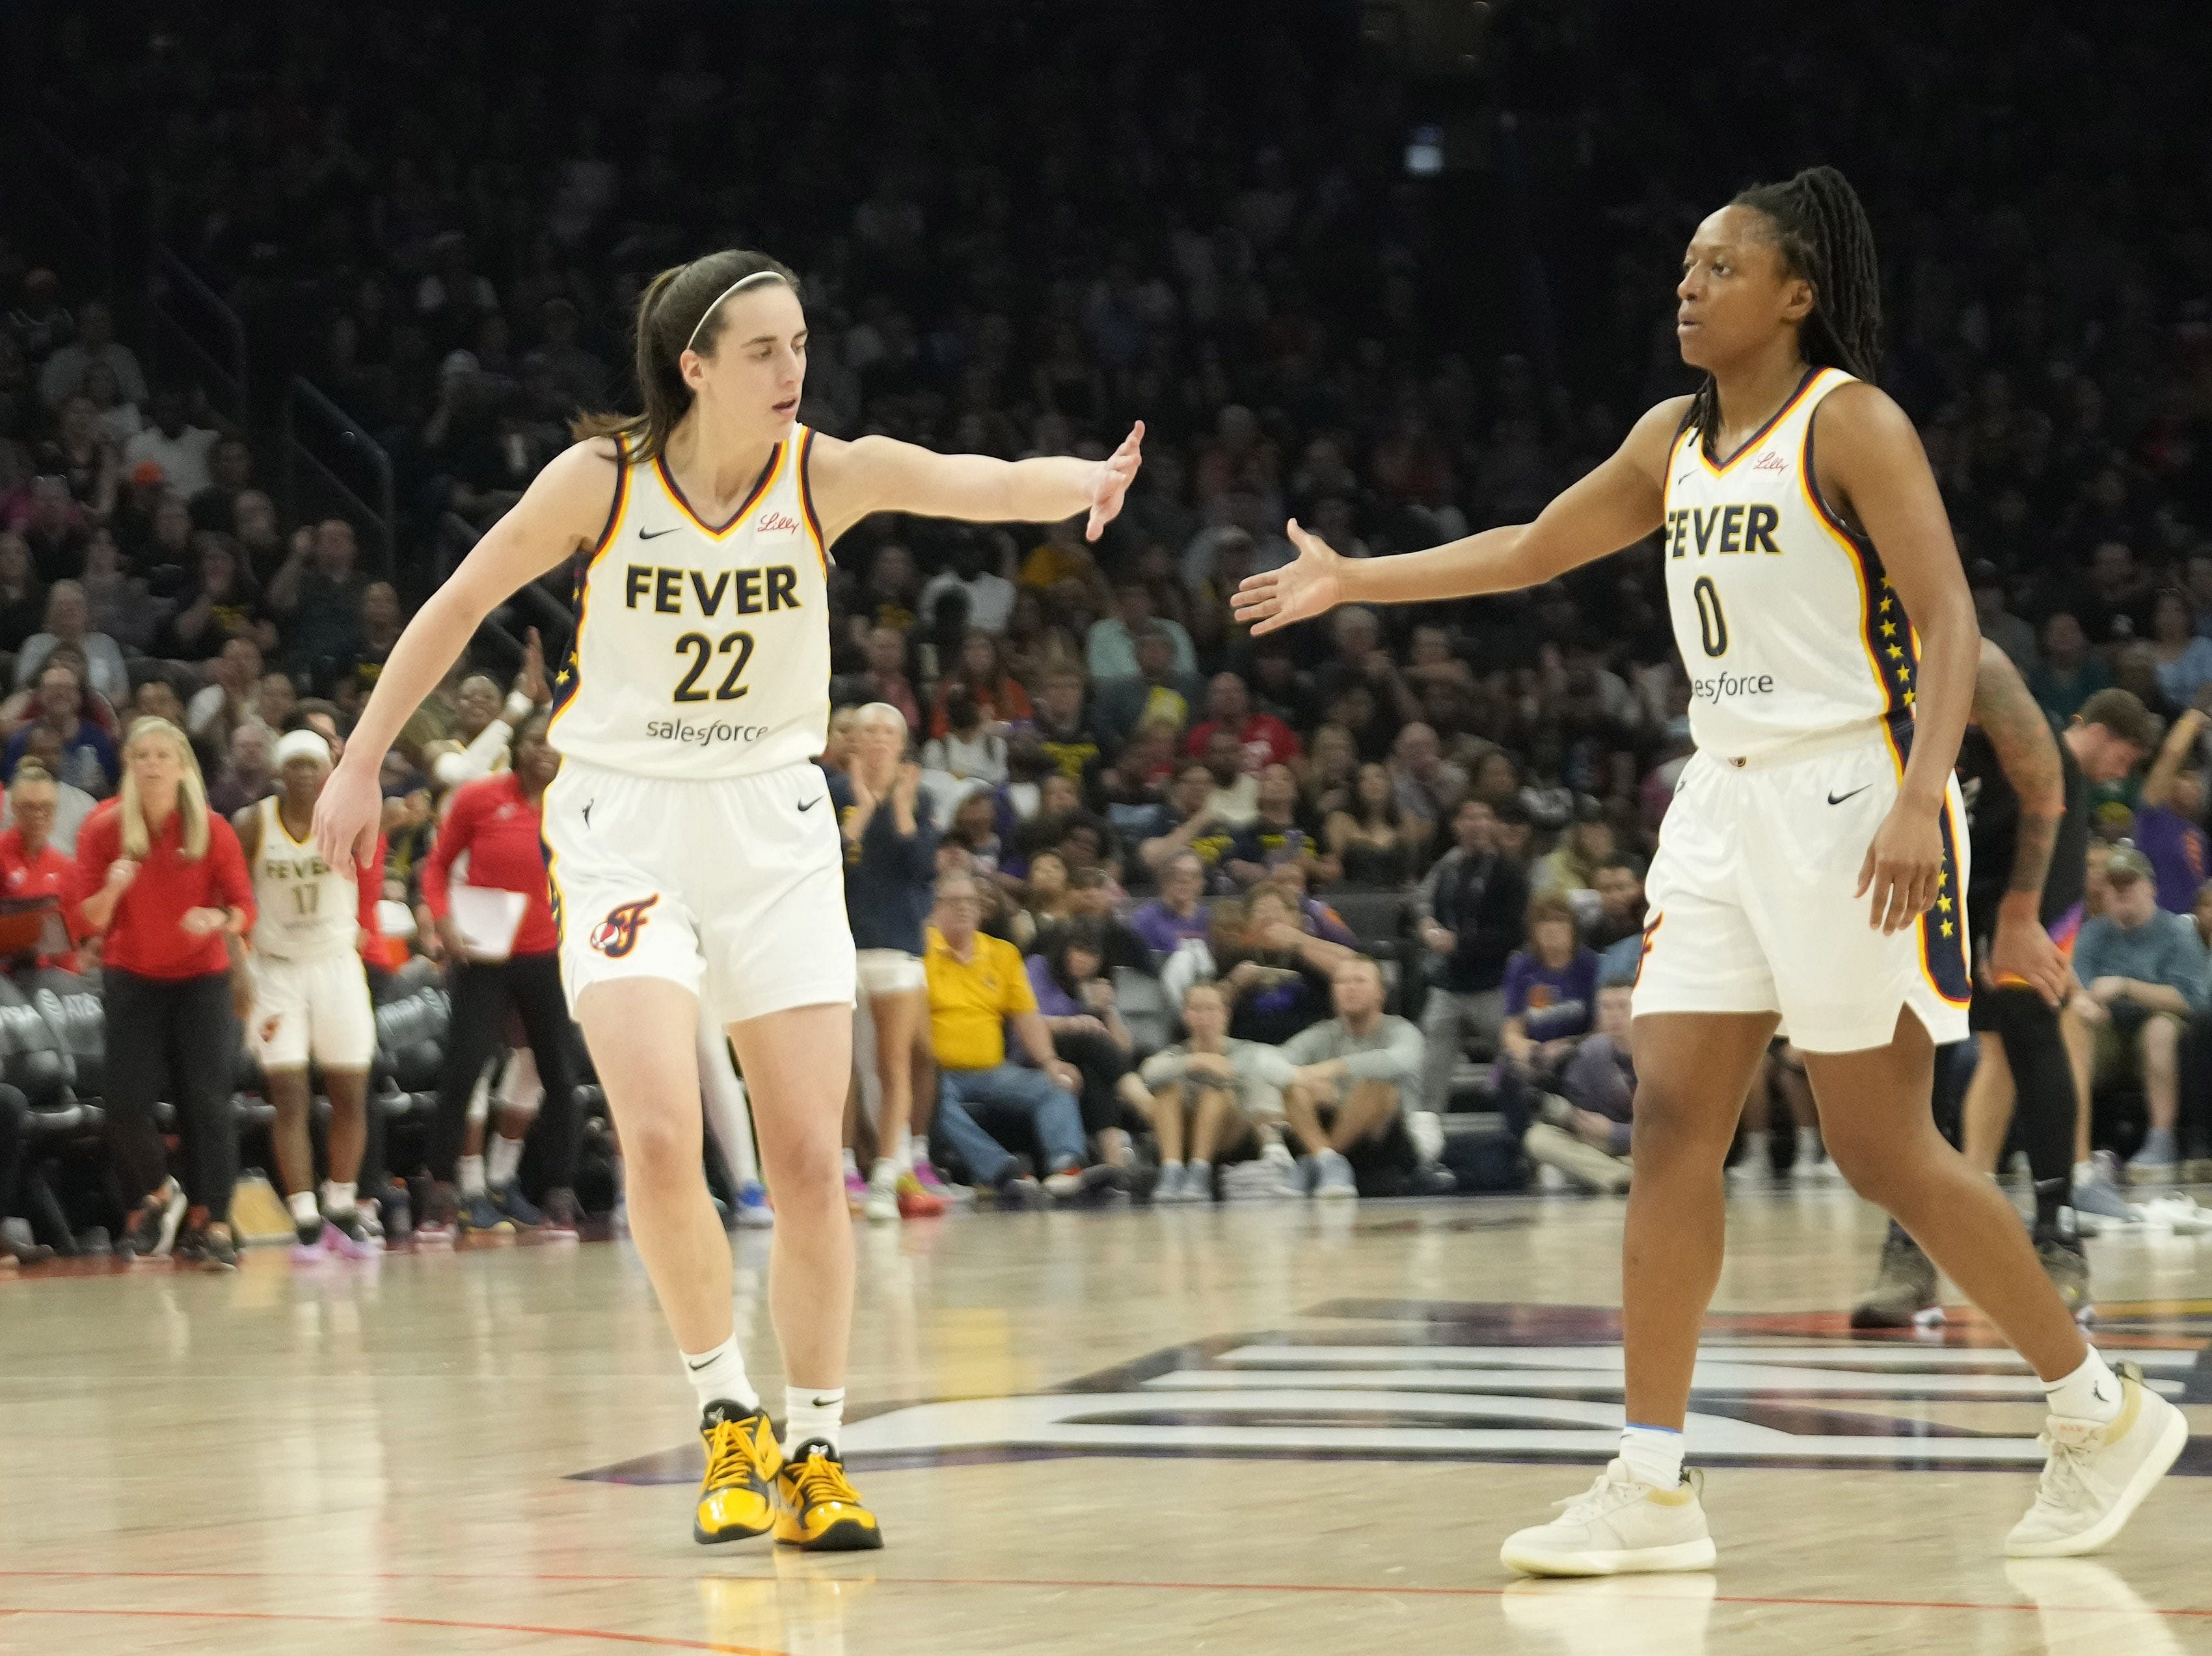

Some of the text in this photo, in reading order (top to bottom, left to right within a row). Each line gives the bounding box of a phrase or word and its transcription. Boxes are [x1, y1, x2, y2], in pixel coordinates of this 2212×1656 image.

[1753, 451, 1788, 474] Lilly
[757, 512, 801, 534] Lilly
[626, 563, 802, 617] FEVER
[1693, 576, 1728, 658] 0
[673, 631, 755, 702] 22
[646, 718, 770, 747] salesforce
